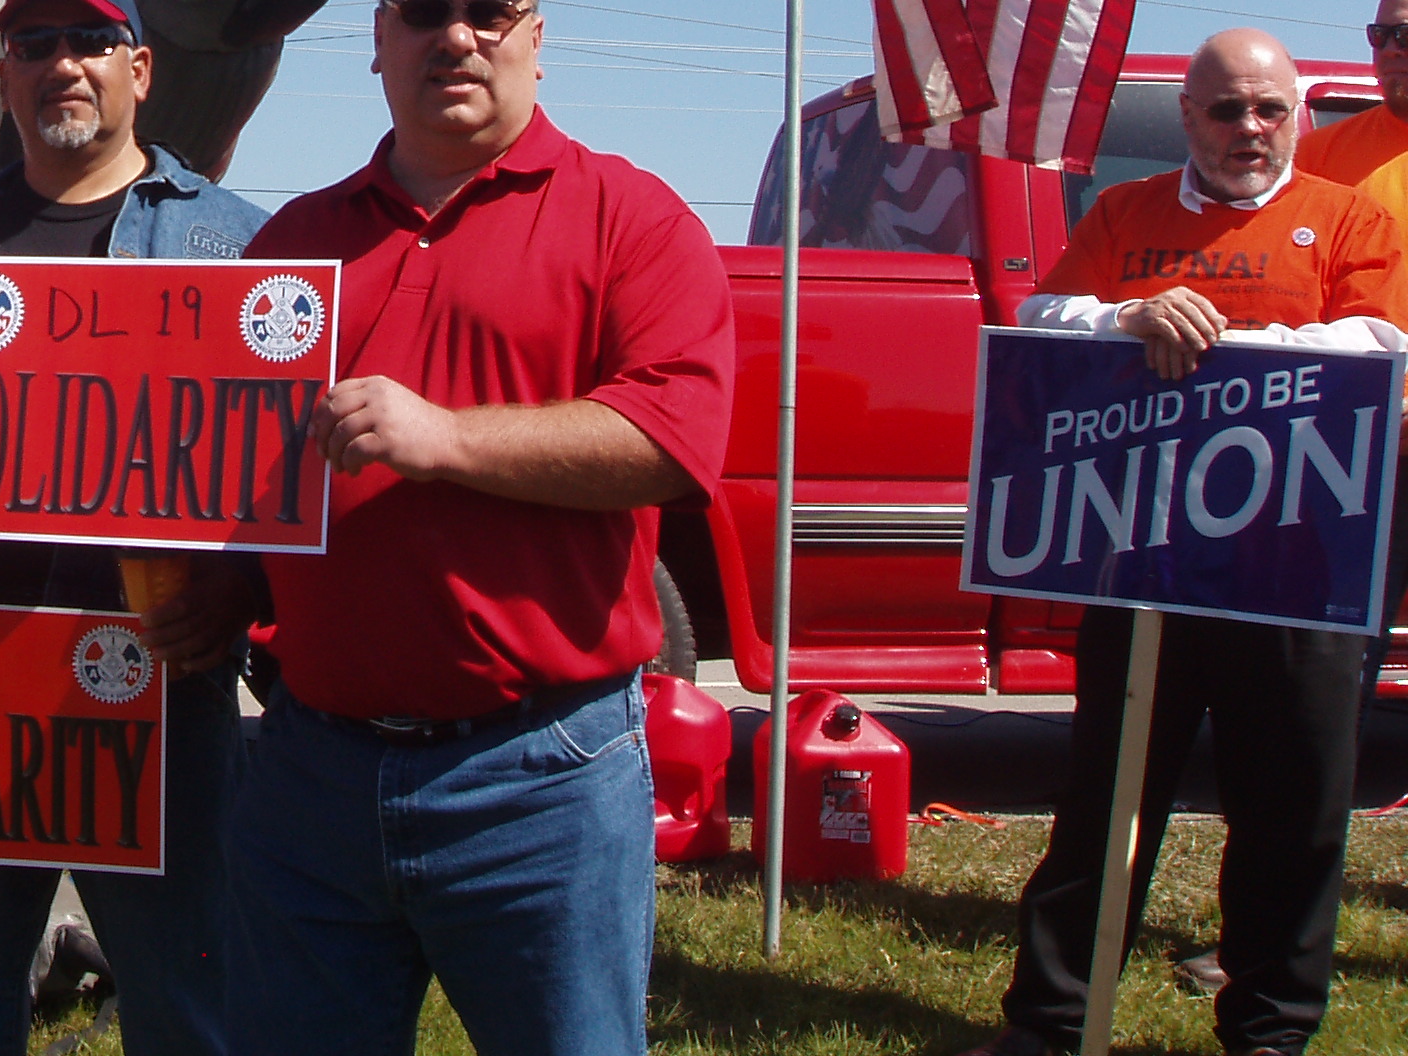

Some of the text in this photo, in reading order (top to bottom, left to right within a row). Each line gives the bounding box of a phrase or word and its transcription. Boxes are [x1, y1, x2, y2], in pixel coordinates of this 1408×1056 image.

[49, 286, 127, 342] DL
[158, 285, 202, 340] 19
[1043, 363, 1323, 454] PROUD TO BE
[987, 405, 1379, 577] UNION
